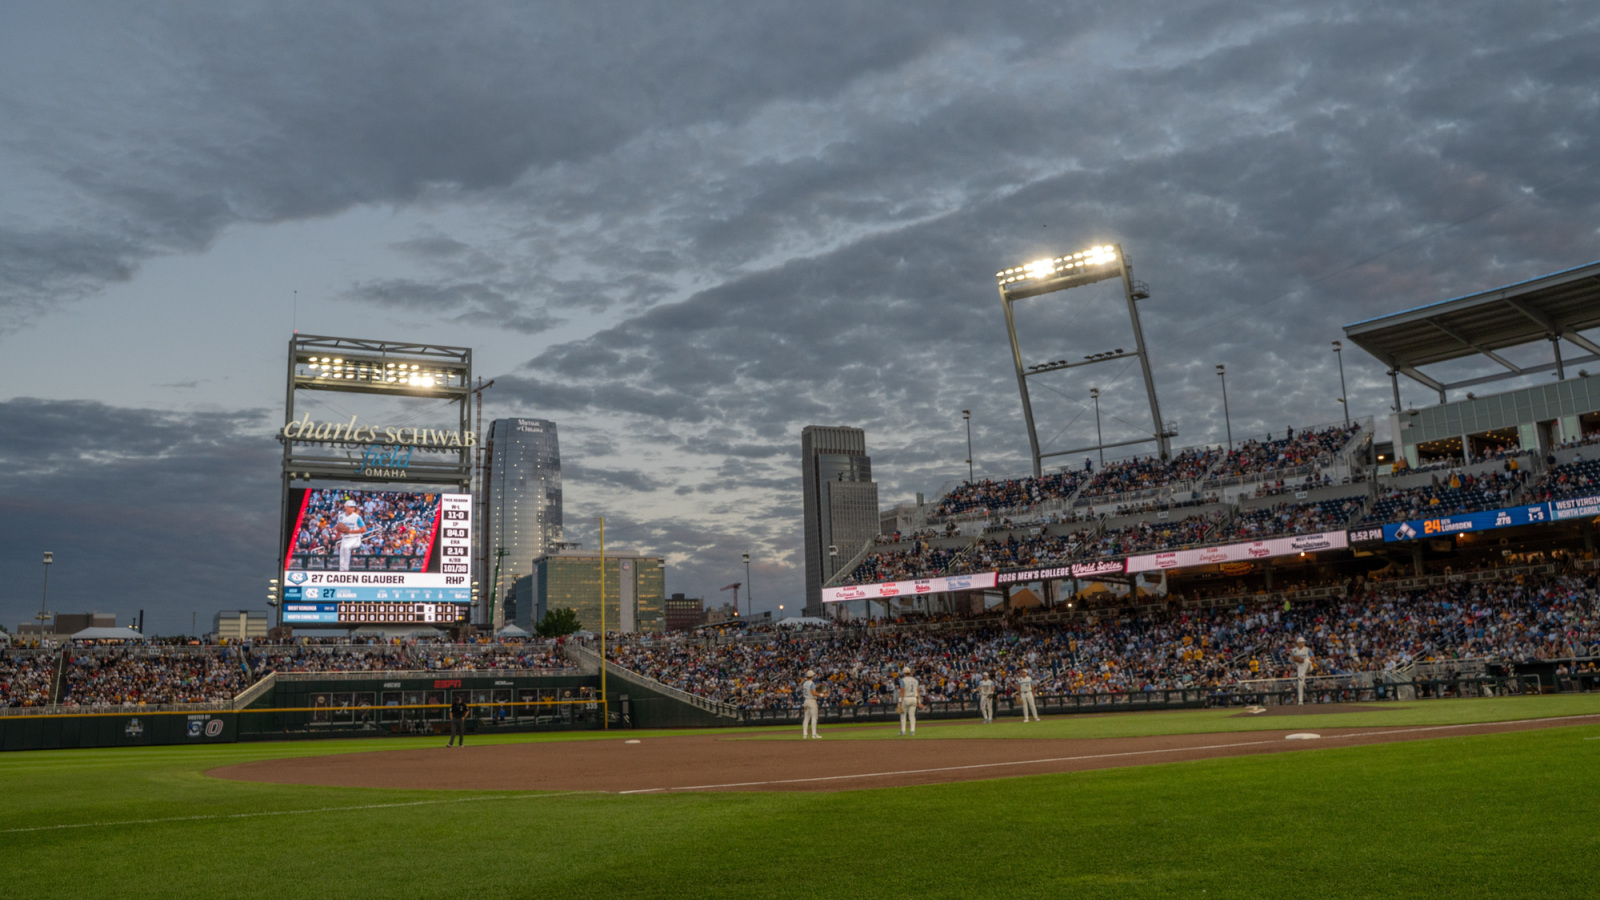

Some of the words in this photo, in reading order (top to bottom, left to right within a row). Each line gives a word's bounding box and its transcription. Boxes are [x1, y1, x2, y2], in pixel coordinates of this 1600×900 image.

[284, 412, 380, 442] charles
[385, 426, 476, 447] SCHWAB
[354, 444, 414, 473] field
[365, 468, 407, 478] OMAHA
[1556, 499, 1575, 509] WEST
[448, 511, 464, 519] 11-0
[1557, 508, 1578, 518] NORTH
[1423, 519, 1441, 534] 24
[1441, 521, 1472, 532] LUMSDEN
[1350, 532, 1368, 542] 8:52
[1369, 528, 1383, 540] PM
[998, 573, 1016, 582] 2026
[1017, 570, 1039, 580] MEN'S
[1040, 567, 1070, 578] COLLEGE
[1072, 563, 1095, 573] World
[1097, 561, 1123, 571] Series
[312, 575, 324, 583] 27
[326, 575, 359, 583] CADEN
[361, 575, 405, 584] GLAUBER
[446, 576, 465, 584] RHP
[323, 588, 336, 598] 27
[434, 680, 462, 688] ESPN
